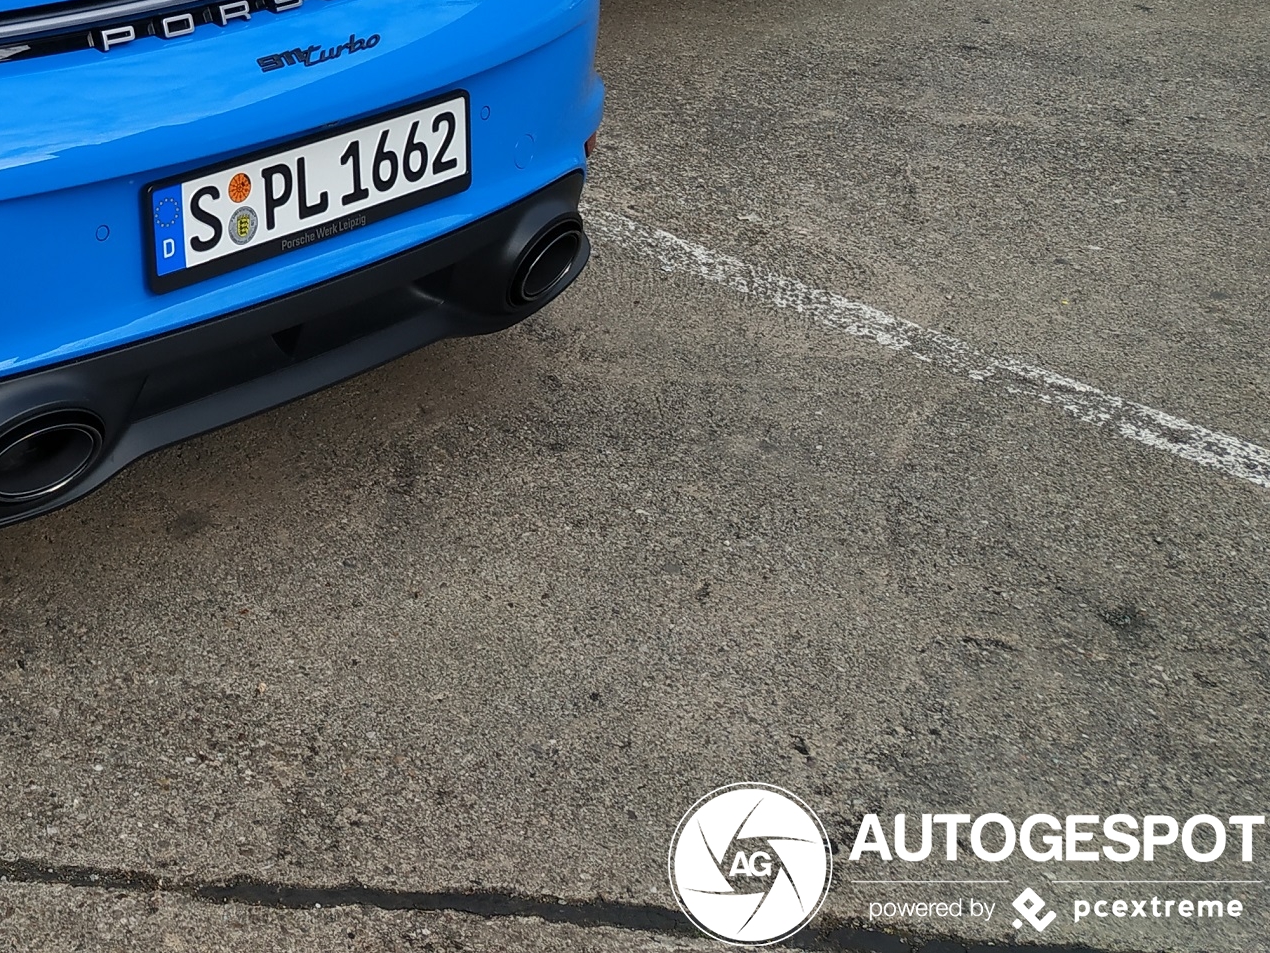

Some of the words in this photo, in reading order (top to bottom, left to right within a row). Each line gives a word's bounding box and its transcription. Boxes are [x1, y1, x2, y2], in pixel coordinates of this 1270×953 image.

[304, 33, 381, 67] turbo
[163, 238, 175, 259] D
[189, 185, 223, 253] S
[261, 156, 329, 231] PL
[340, 111, 458, 206] 1662
[281, 232, 315, 251] Porsche
[316, 224, 338, 239] Werk
[339, 214, 366, 232] Leipzig
